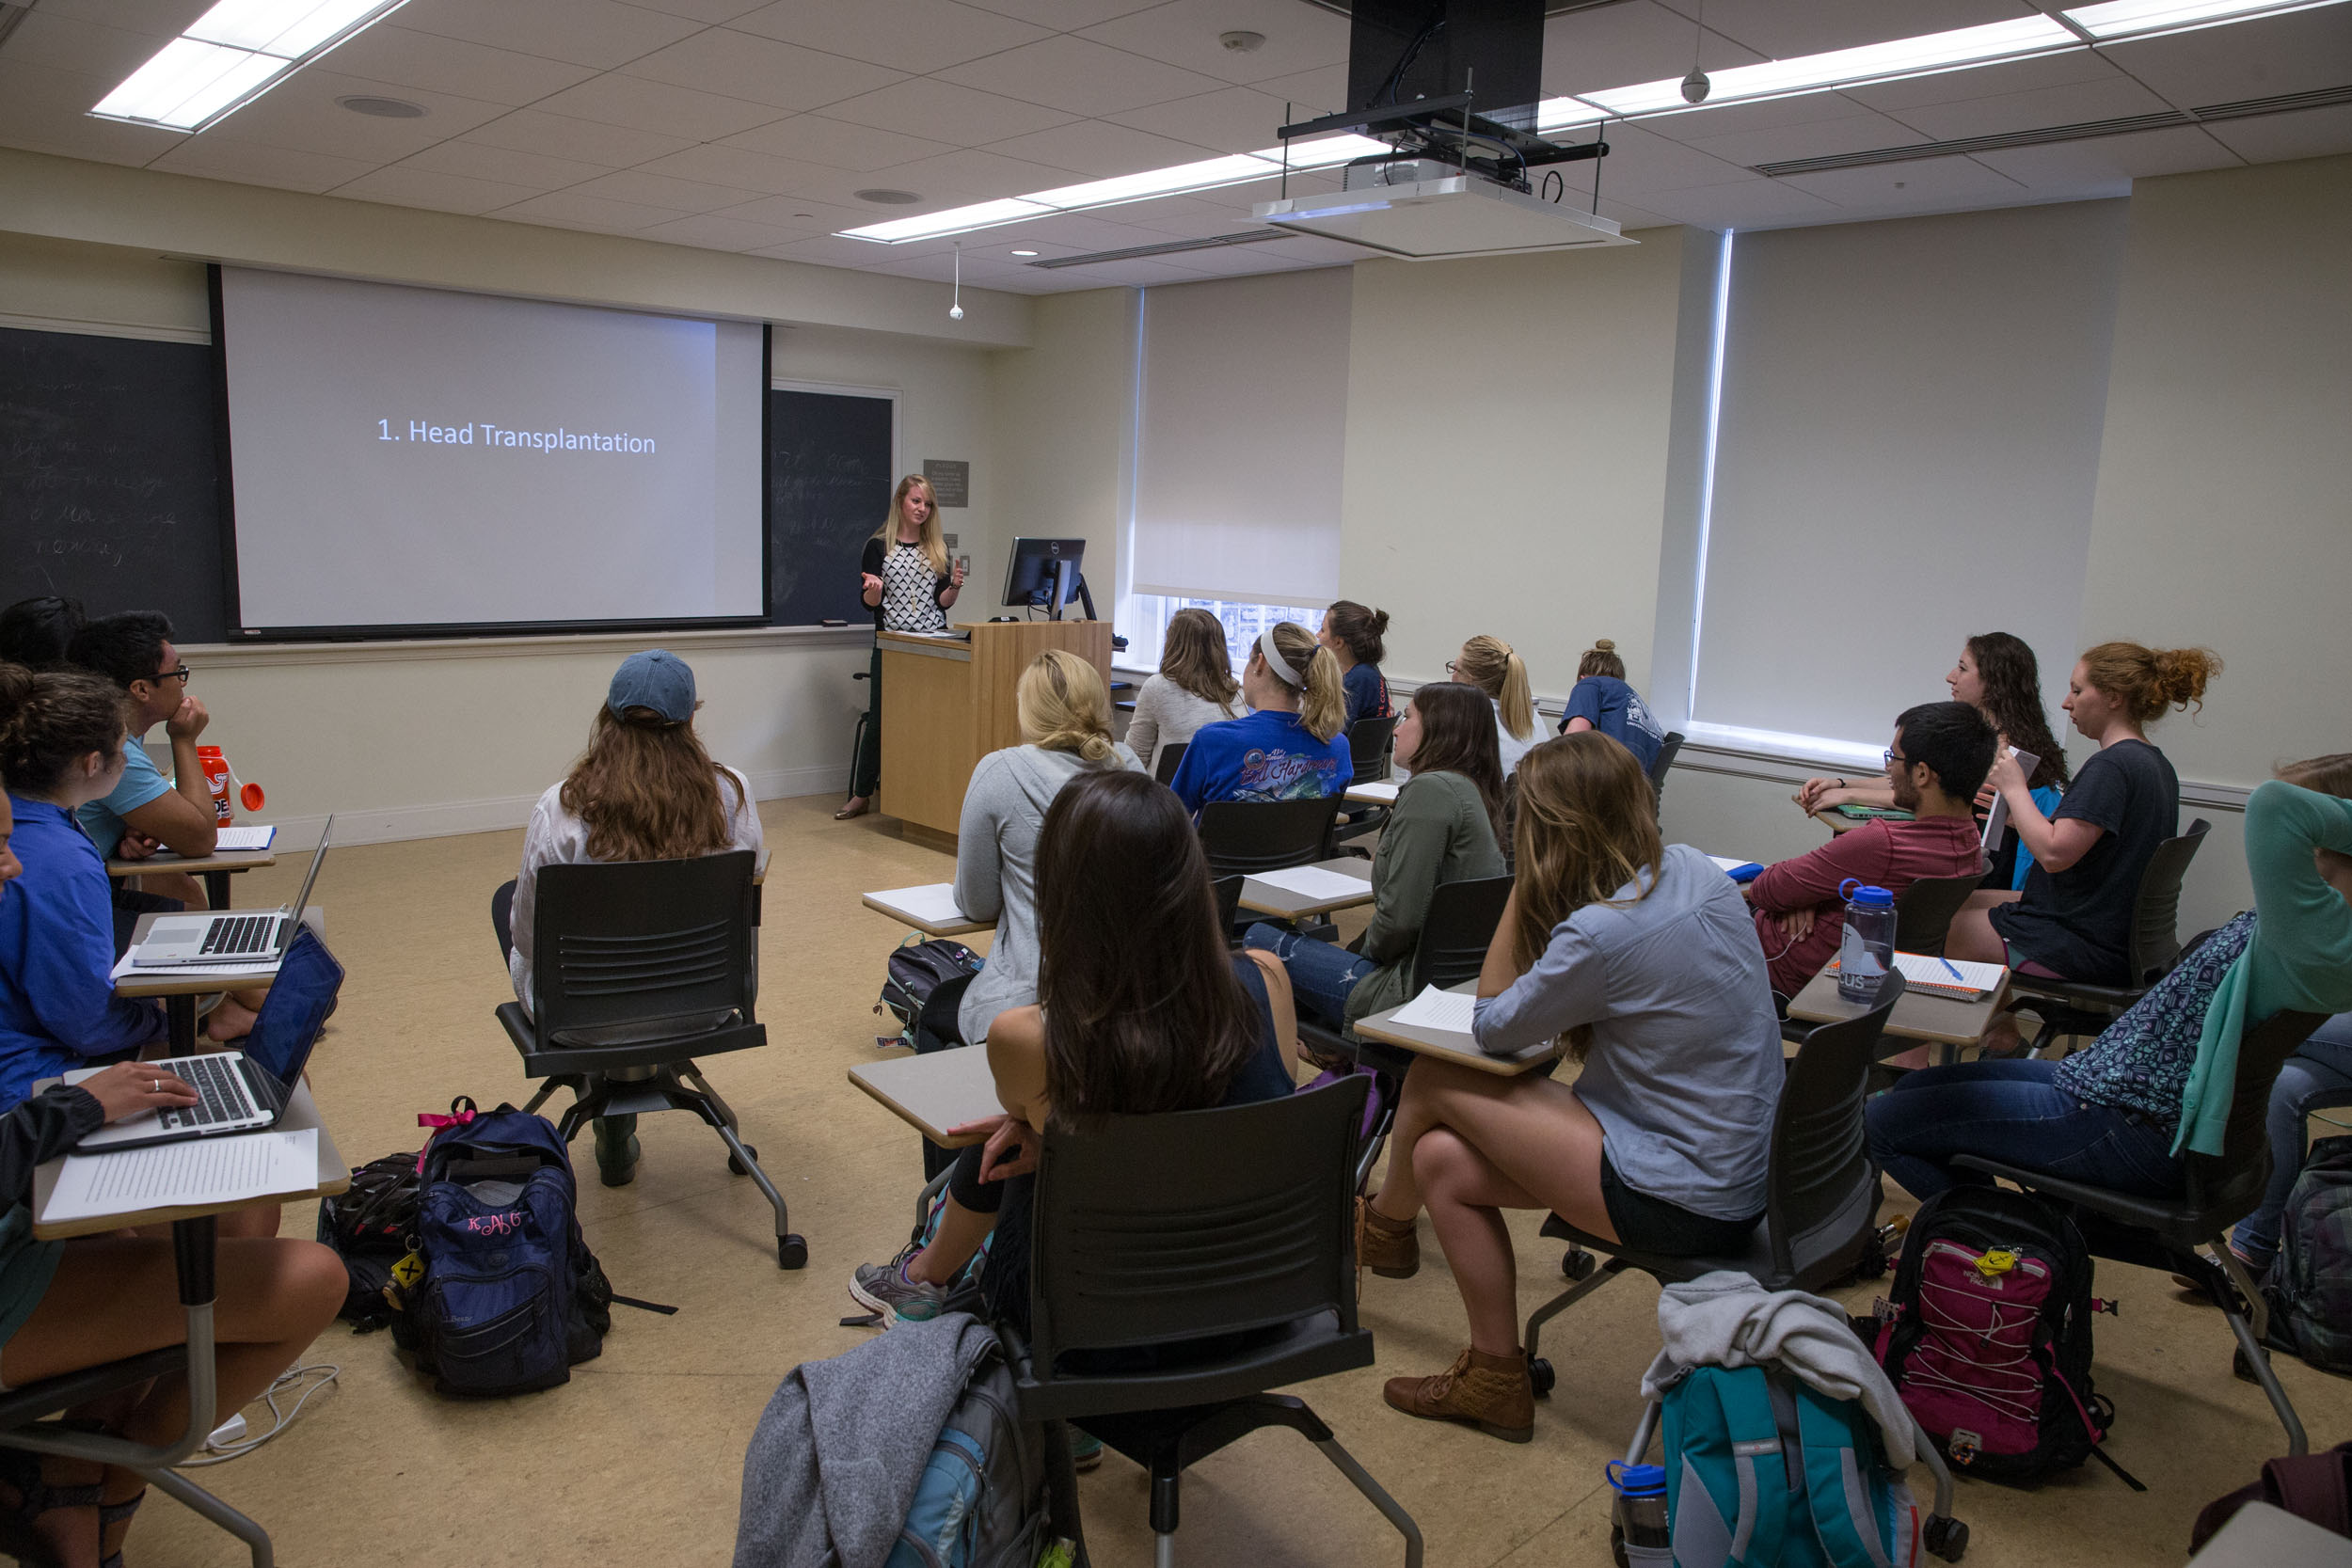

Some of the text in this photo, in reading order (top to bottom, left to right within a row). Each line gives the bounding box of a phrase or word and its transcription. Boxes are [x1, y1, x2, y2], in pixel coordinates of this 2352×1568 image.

[377, 419, 656, 454] 1. Head Transplantation
